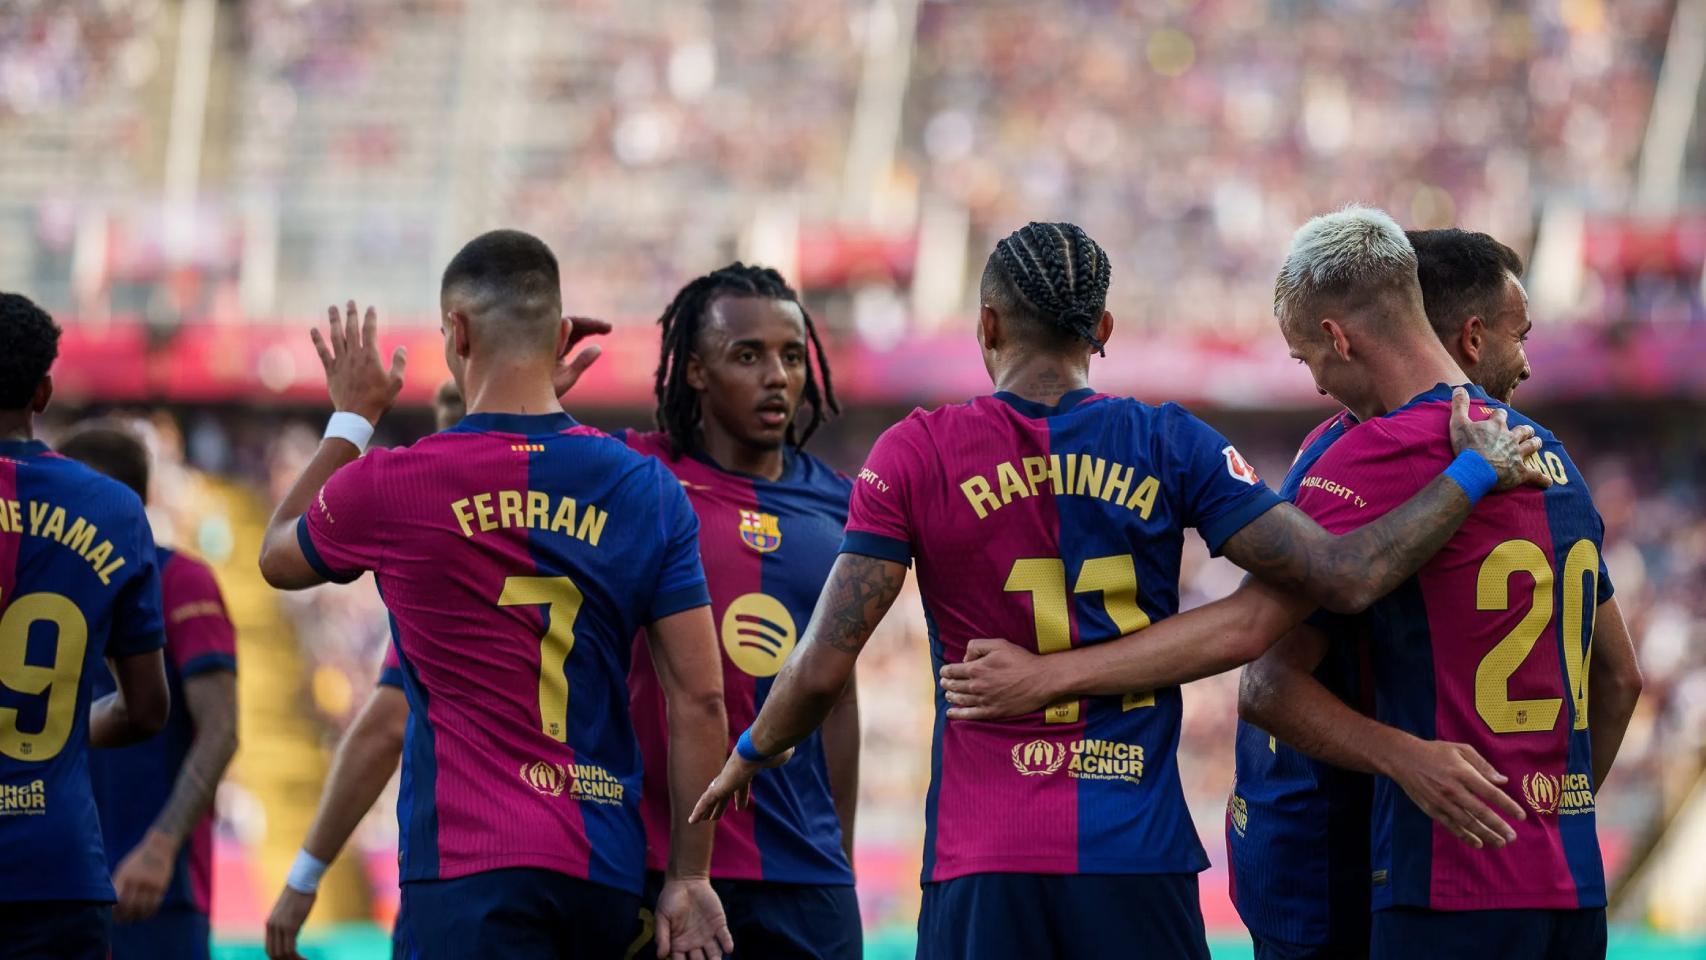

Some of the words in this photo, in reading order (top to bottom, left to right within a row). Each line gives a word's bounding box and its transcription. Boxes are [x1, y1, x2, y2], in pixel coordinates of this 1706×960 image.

[960, 453, 1160, 521] RAPHINHA
[1299, 475, 1354, 501] MBILIGHT
[1354, 494, 1368, 509] tv
[29, 500, 126, 586] YAMAL
[451, 490, 608, 547] FERRAN
[496, 576, 584, 743] 7
[1003, 554, 1156, 724] 11
[1475, 539, 1599, 733] 20
[0, 592, 88, 762] 9
[1067, 753, 1144, 779] ACNUR
[1070, 739, 1144, 761] UNHCR
[0, 779, 45, 798] HCR
[569, 778, 625, 801] ACNUR
